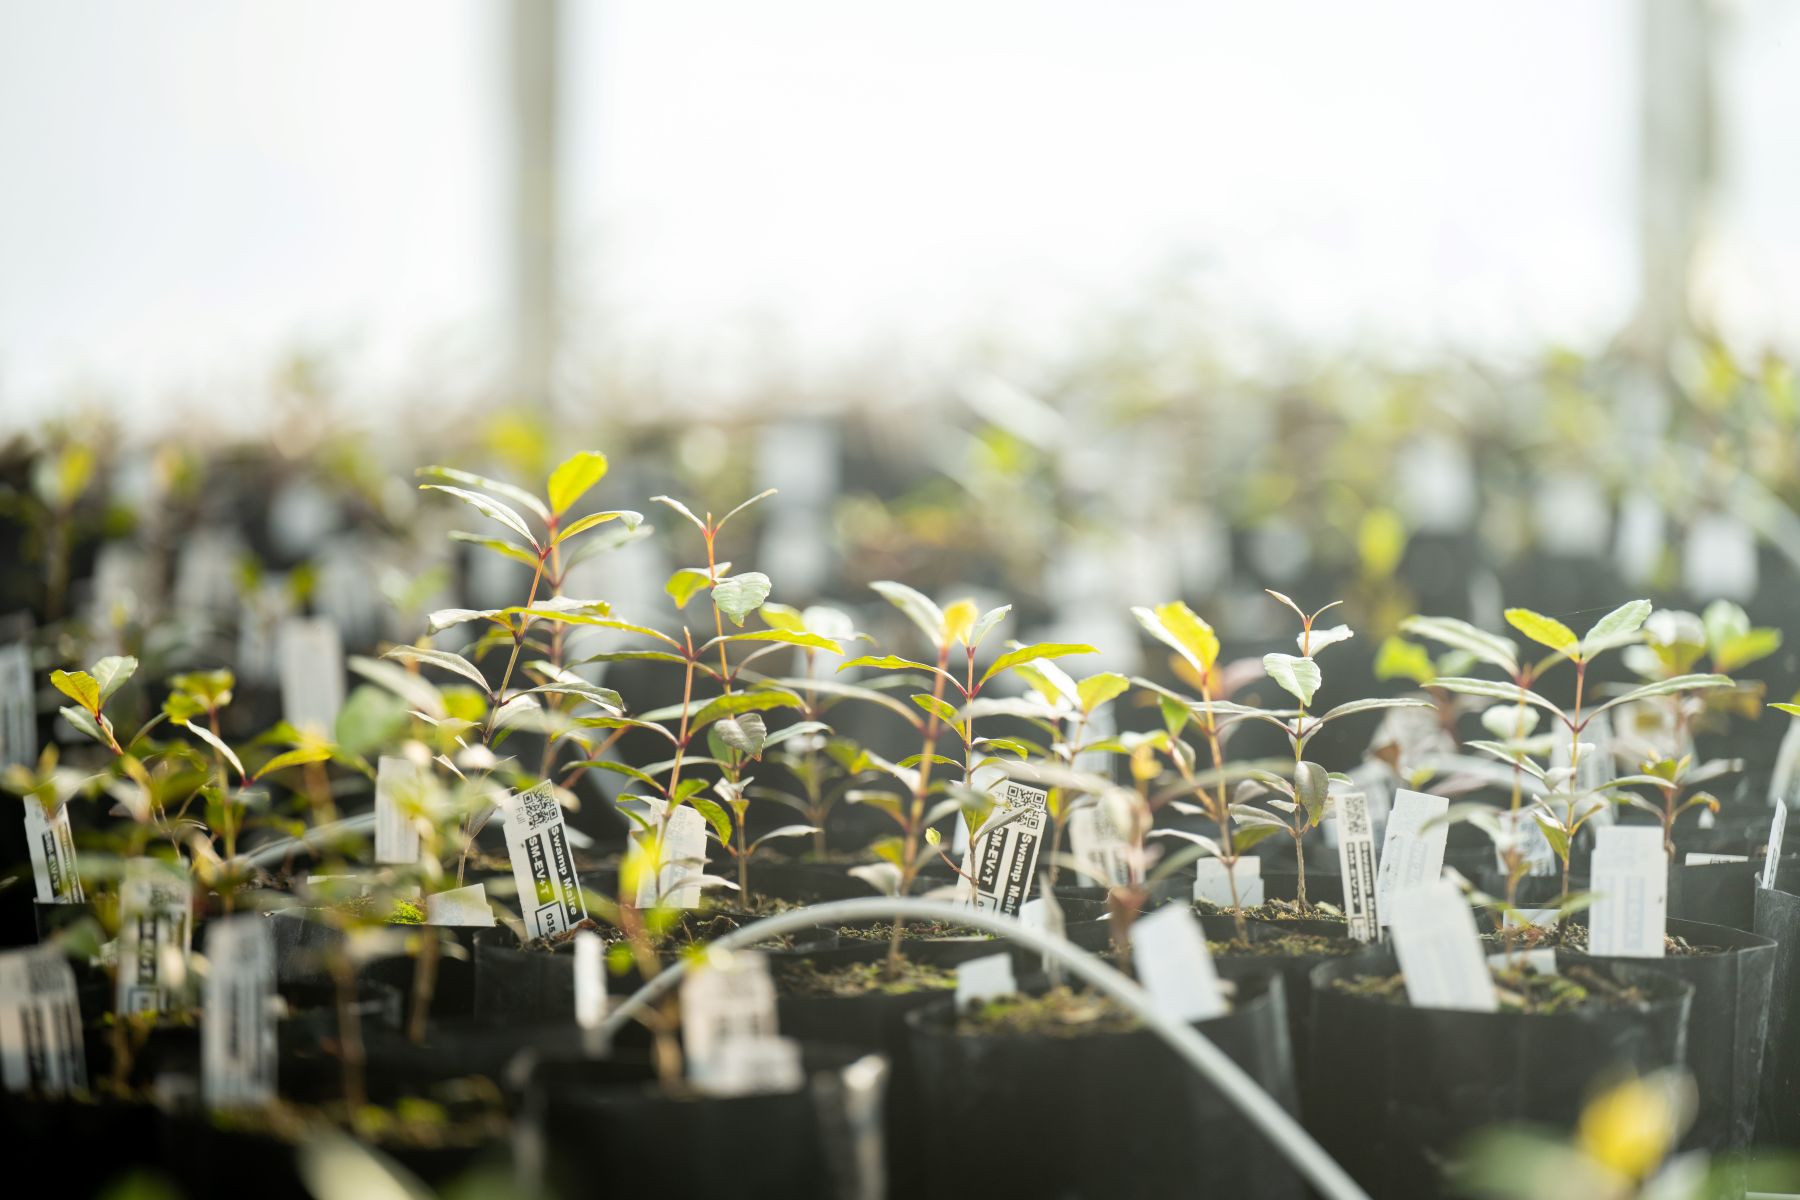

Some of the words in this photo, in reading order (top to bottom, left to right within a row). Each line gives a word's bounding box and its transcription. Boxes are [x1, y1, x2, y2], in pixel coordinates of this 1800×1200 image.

[528, 836, 550, 895] SM-EV+T
[551, 825, 568, 876] Swamp
[563, 878, 577, 915] Maire
[982, 827, 1004, 885] SM-EV+T
[1010, 834, 1033, 882] Swamp
[1361, 842, 1372, 894] Swamp
[1004, 884, 1021, 915] Mair
